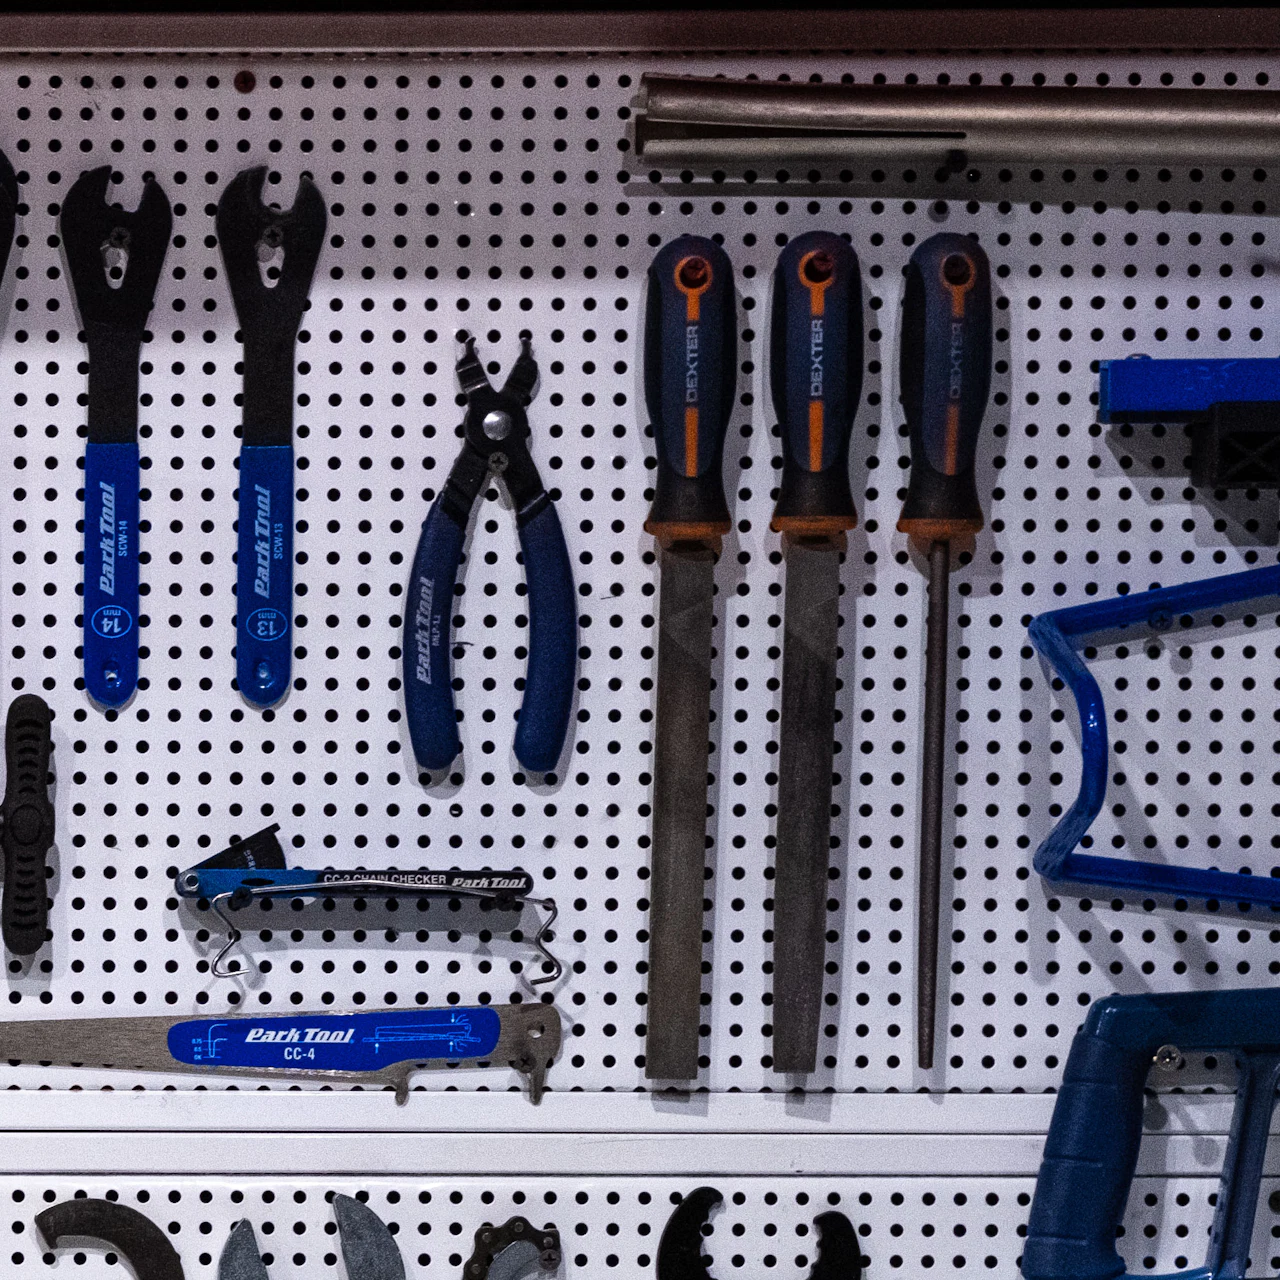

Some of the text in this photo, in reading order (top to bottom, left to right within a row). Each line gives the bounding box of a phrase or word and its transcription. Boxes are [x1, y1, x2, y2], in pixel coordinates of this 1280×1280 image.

[685, 325, 699, 402] DEXTER
[810, 319, 824, 397] DEXTER
[949, 322, 963, 399] DEXTER
[99, 481, 116, 597] Park Tool
[118, 520, 128, 557] SCW-14
[254, 484, 271, 599] Park Tool
[274, 523, 284, 560] SCW-13
[101, 618, 122, 634] 14
[257, 621, 277, 636] 13
[414, 576, 435, 685] Park Tool
[391, 874, 447, 885] CHECKER
[452, 877, 526, 888] Park Tool
[244, 1028, 355, 1043] Park Tool
[284, 1048, 315, 1060] CC-4
